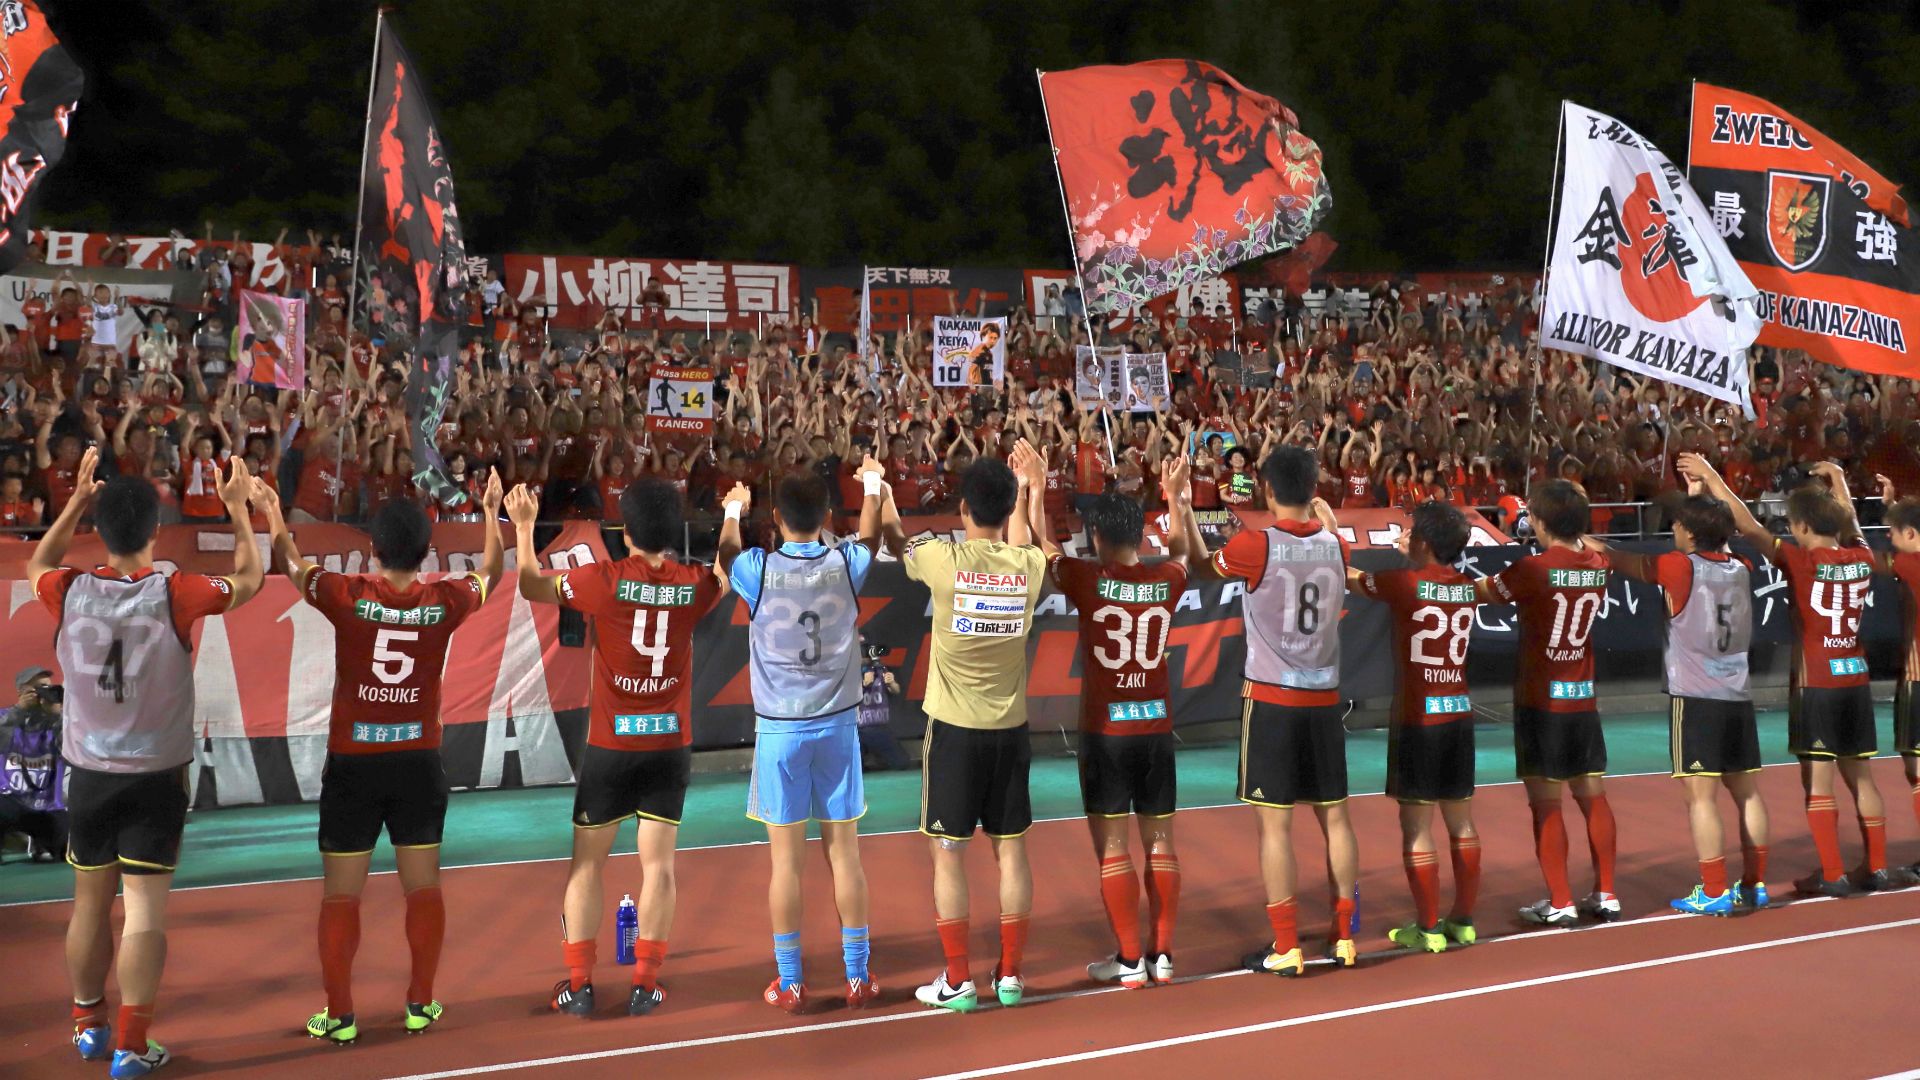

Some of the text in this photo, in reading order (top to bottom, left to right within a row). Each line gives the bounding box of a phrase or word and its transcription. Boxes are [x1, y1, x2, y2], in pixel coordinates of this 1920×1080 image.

[1709, 191, 1899, 266] 最 強
[868, 266, 952, 286] 天下無双
[516, 256, 791, 325] 小柳達司
[938, 320, 982, 332] NAKAMI
[1550, 310, 1588, 344] ALL
[1756, 289, 1907, 354] OF KANAZAWA
[938, 335, 969, 347] KEIYA
[656, 368, 709, 380] Masa HERO
[938, 366, 961, 383] 10
[680, 391, 706, 408] 14
[656, 419, 704, 430] KANEKO
[1047, 478, 1058, 489] 36
[1354, 484, 1365, 496] 20
[1272, 543, 1339, 562] 北國銀行
[956, 571, 1027, 587] NISSAN
[1552, 570, 1606, 587] 北國銀行
[1818, 562, 1870, 581] 北國銀行
[619, 583, 694, 606] 北國銀行
[1098, 582, 1169, 603] 北國銀行
[1420, 582, 1475, 602] 北國銀行
[357, 600, 444, 626] 北國銀行
[1298, 581, 1320, 636] 8
[1810, 579, 1870, 636] 45
[974, 621, 1022, 634] 日成ビルド
[1548, 592, 1601, 648] 10
[1717, 604, 1732, 653] 5
[631, 609, 671, 677] 4
[797, 610, 822, 667] 3
[1092, 605, 1171, 670] 30
[1410, 605, 1475, 666] 28
[370, 628, 420, 685] 5
[97, 639, 124, 704] 4
[1115, 672, 1146, 689] ZAKI
[1424, 668, 1462, 683] RYOMA
[357, 683, 419, 703] KOSUKE
